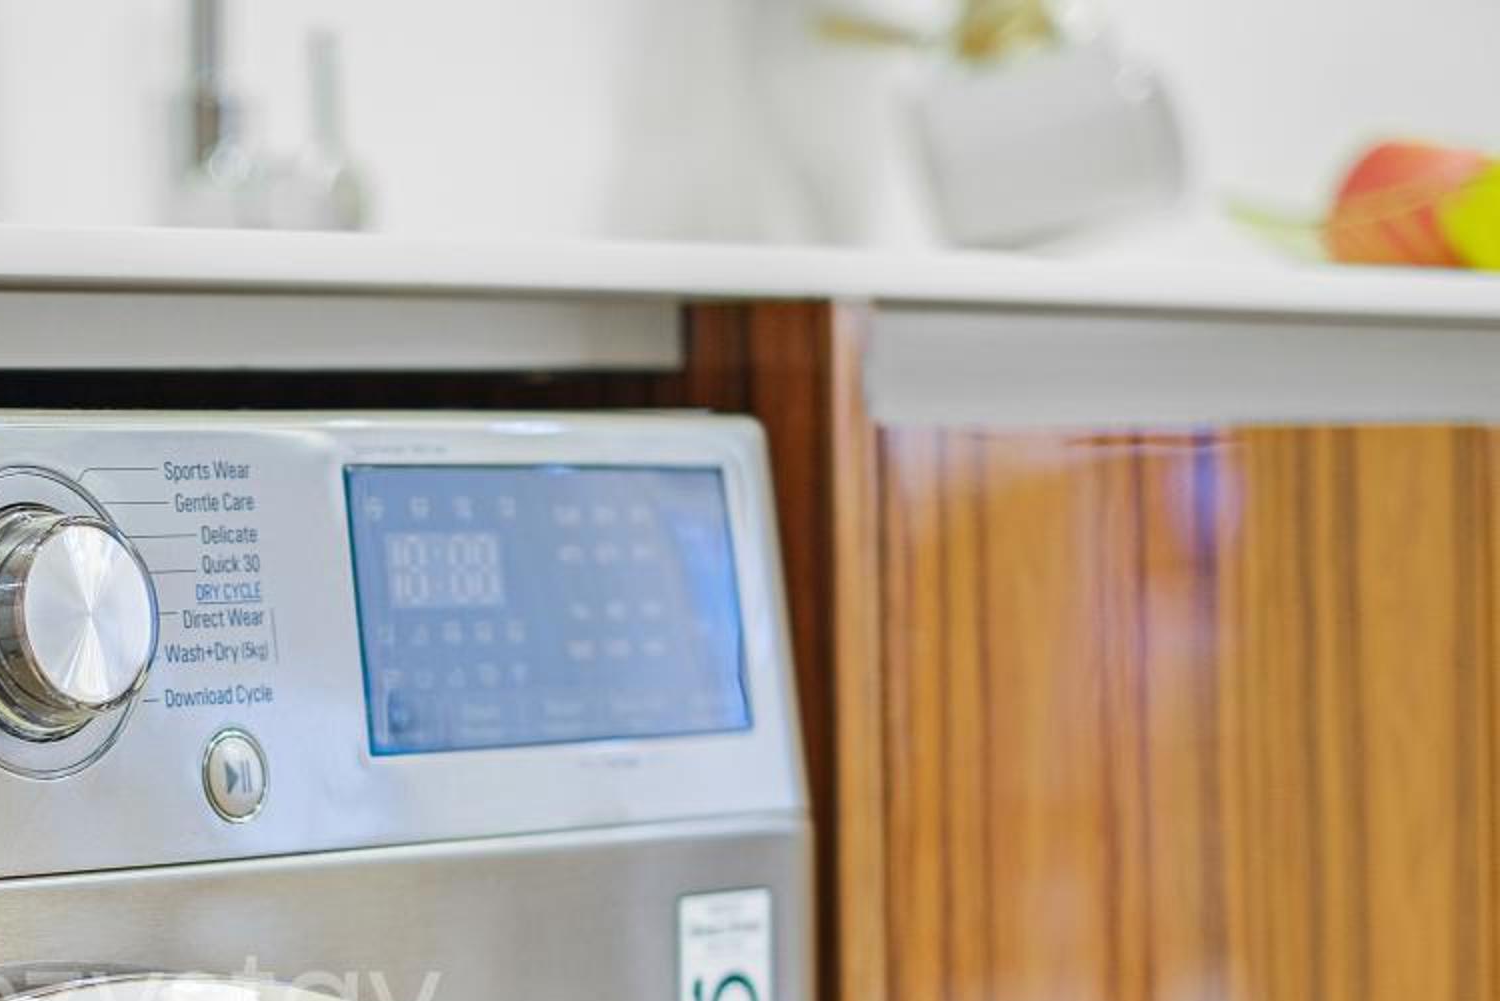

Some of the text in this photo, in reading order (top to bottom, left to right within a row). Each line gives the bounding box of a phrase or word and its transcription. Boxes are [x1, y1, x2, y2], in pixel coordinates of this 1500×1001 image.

[163, 459, 250, 483] Sports Wear
[175, 492, 255, 512] Gentle Care
[201, 525, 258, 544] Delicate
[201, 553, 261, 574] Quick 30
[196, 581, 261, 601] DRY CYCLE
[183, 606, 264, 628] Direct Wear
[165, 641, 239, 664] Wash+Dry
[164, 684, 275, 708] Download Cycle
